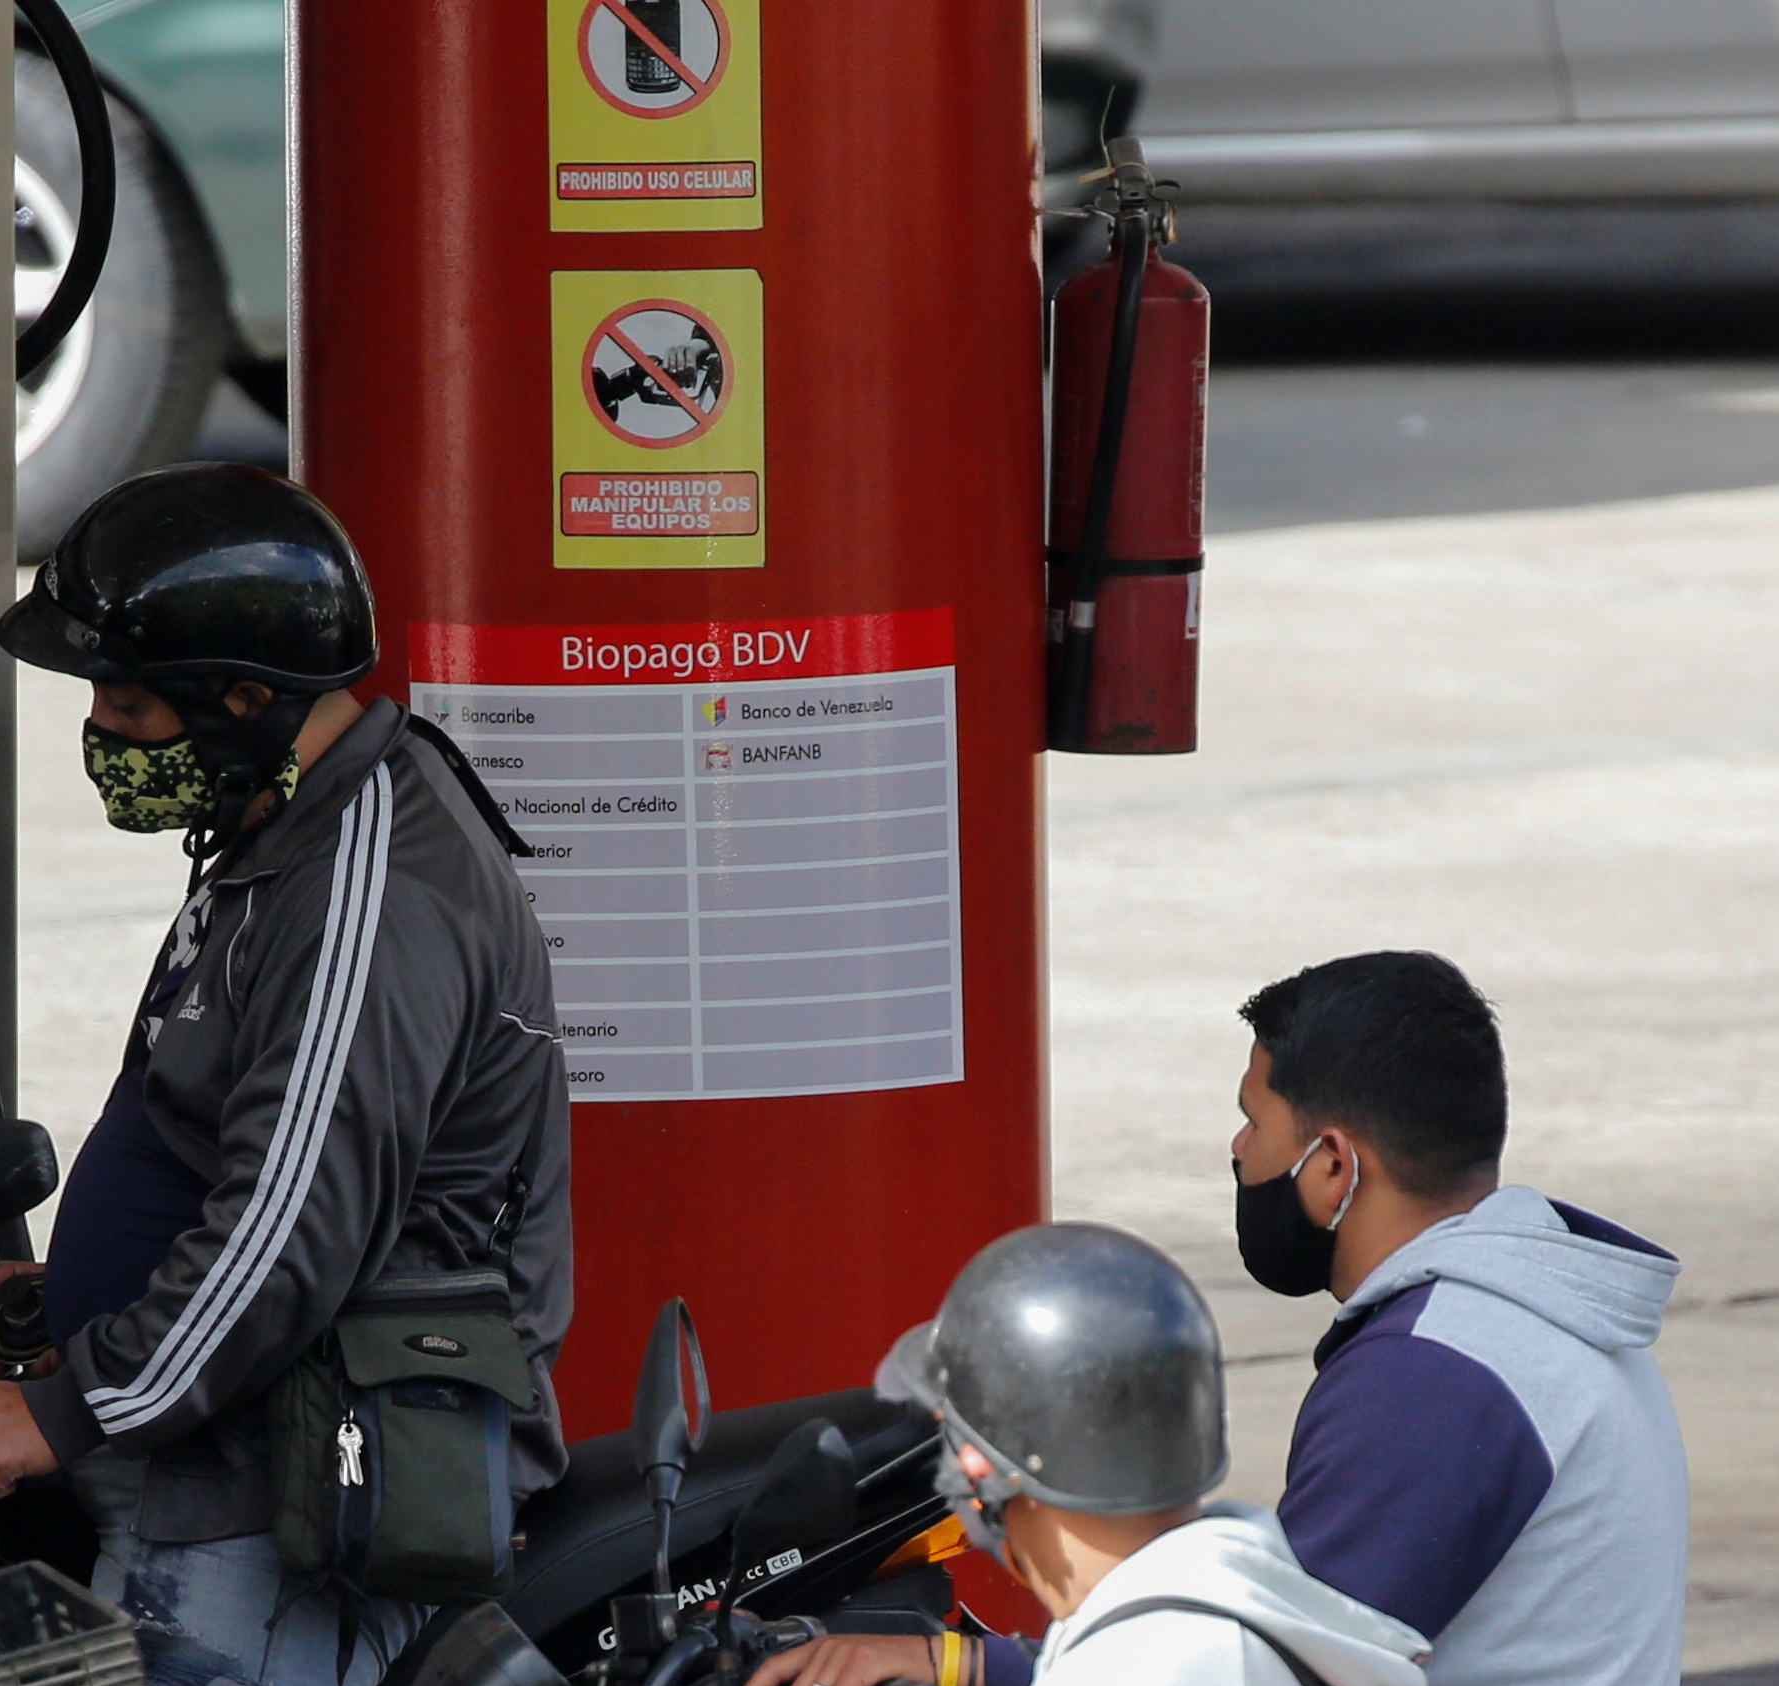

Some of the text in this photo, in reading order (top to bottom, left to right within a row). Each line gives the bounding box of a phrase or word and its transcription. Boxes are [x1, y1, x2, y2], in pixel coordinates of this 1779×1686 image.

[559, 169, 753, 190] PROHIBIDO USO CELULAR
[599, 480, 723, 496] PROHIBIDO
[571, 496, 752, 513] MANIPULAR LOS
[612, 513, 711, 530] EQUIPOS
[561, 629, 812, 677] Biopago BDV
[461, 706, 535, 725] Bancaribe
[741, 695, 894, 720] Banco de Venezuela
[742, 744, 822, 764] BANFANB
[515, 797, 585, 814] Nacional
[591, 797, 611, 813] de
[617, 795, 678, 813] Crédito
[770, 1551, 799, 1570] CBF
